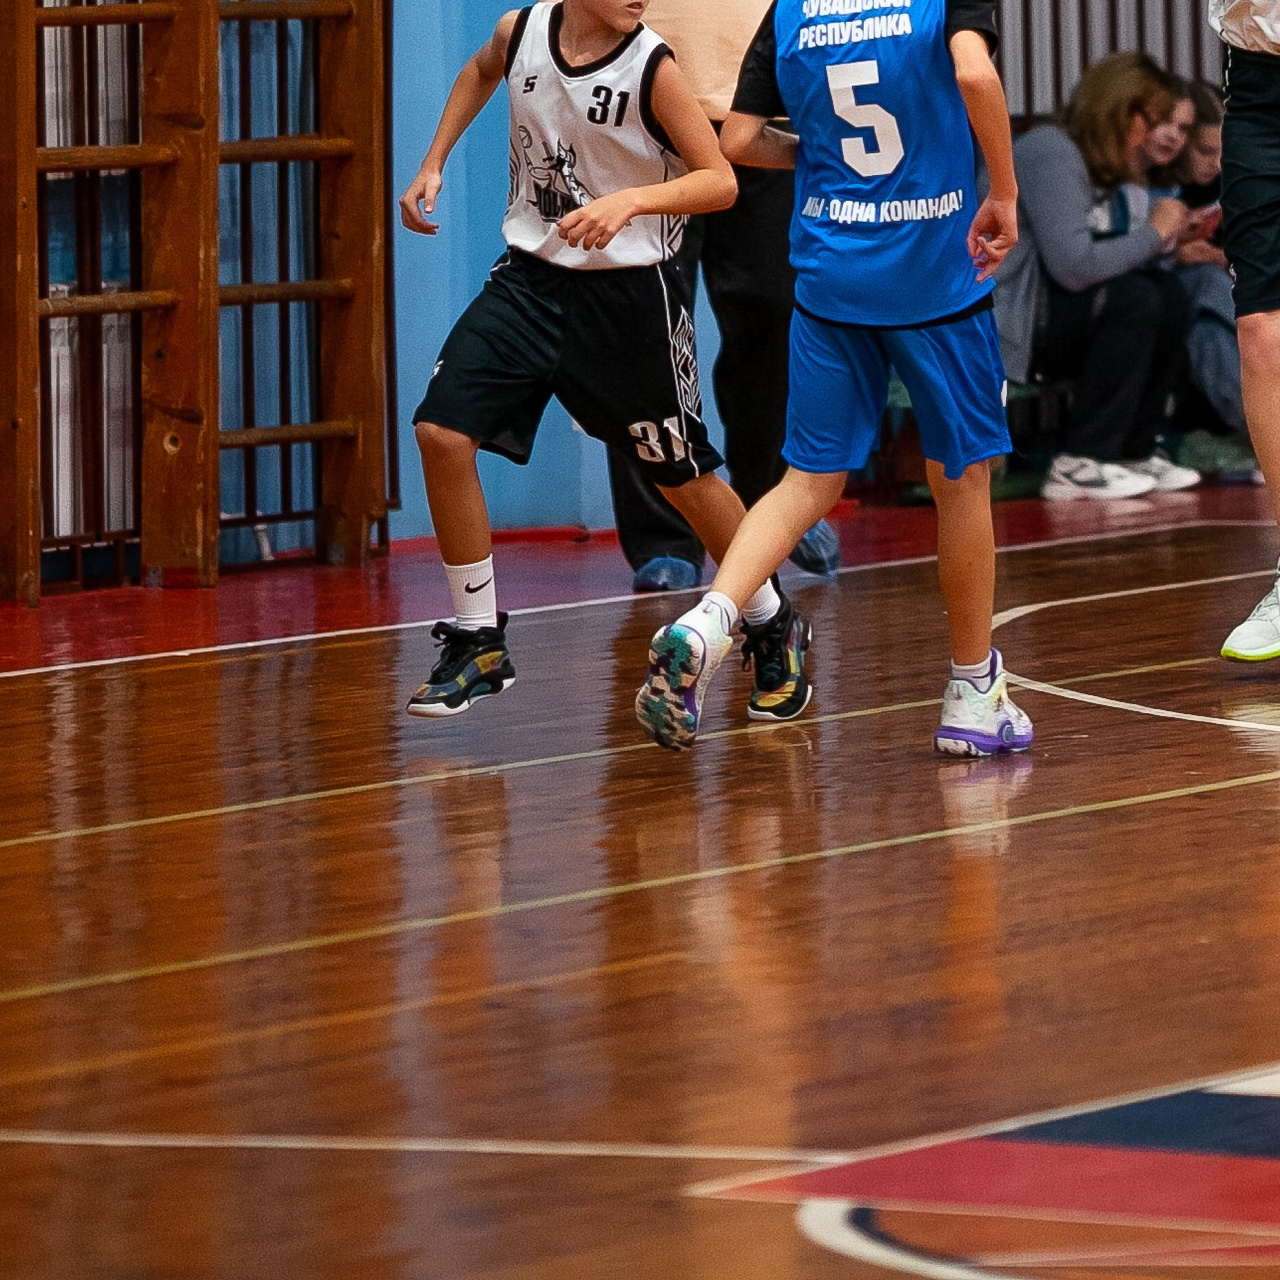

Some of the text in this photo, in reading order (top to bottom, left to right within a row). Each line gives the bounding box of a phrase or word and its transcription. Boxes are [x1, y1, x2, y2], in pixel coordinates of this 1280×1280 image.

[799, 13, 912, 50] РЕСПУБЛИКА
[587, 85, 630, 127] 31
[826, 60, 905, 178] 5
[802, 189, 963, 224] МЫ ОДНА КОМАНДА!
[628, 416, 686, 463] 31
